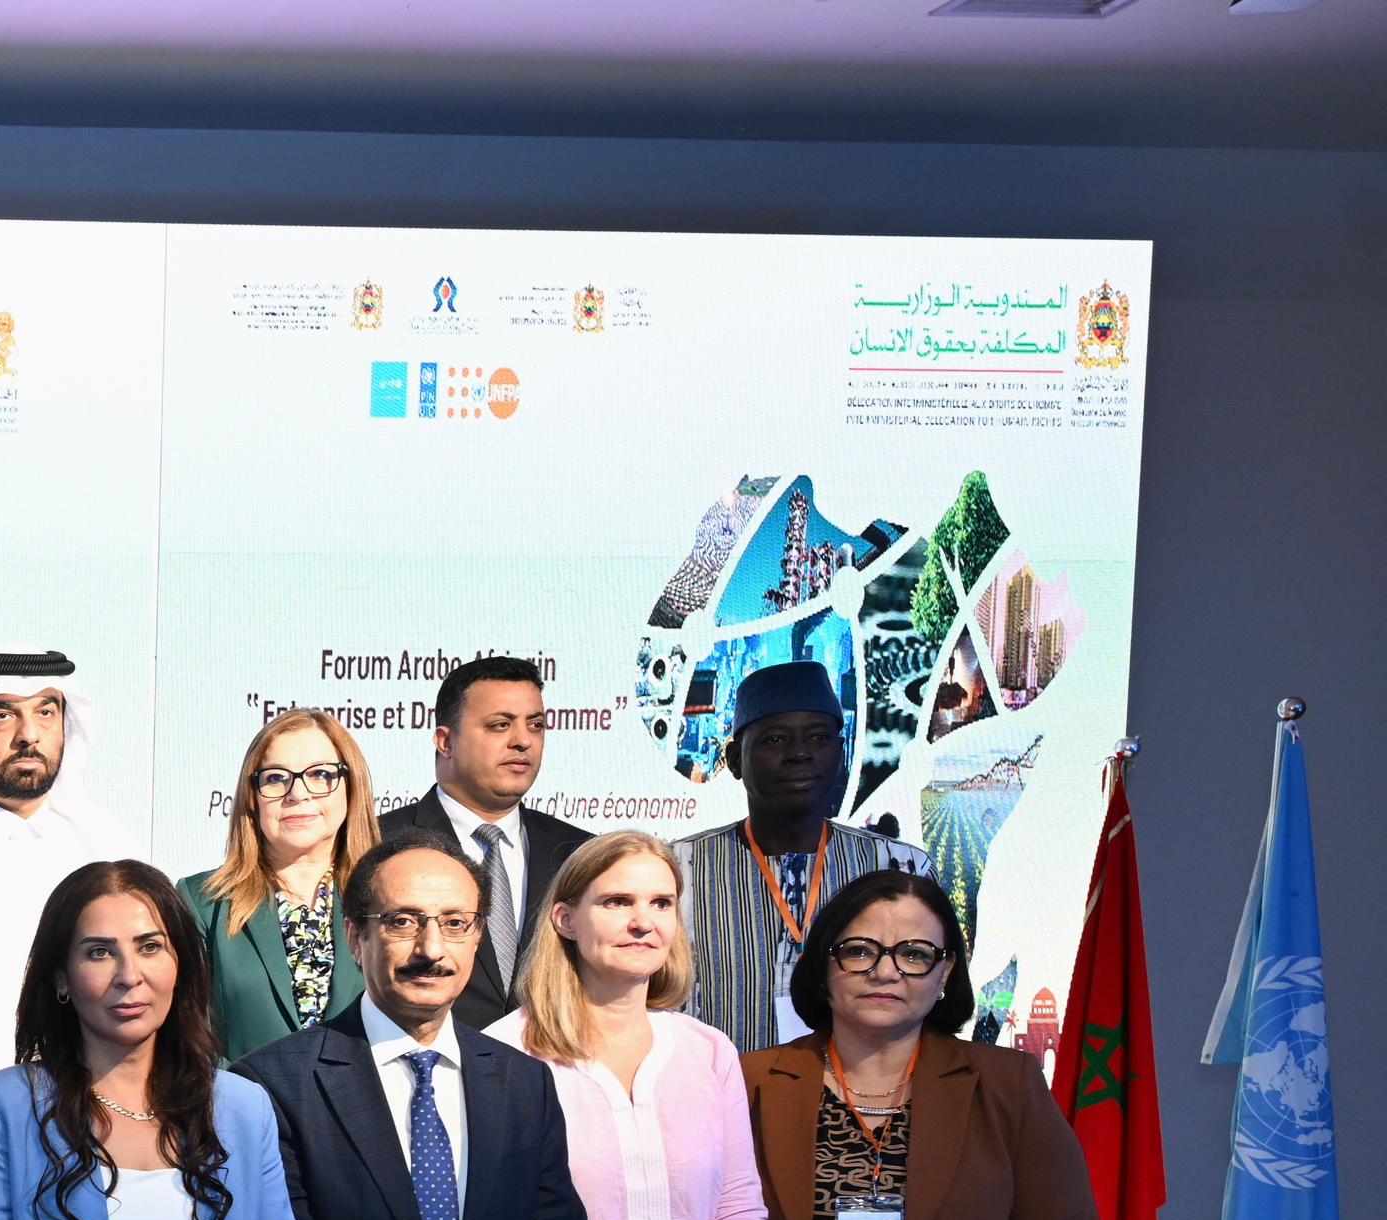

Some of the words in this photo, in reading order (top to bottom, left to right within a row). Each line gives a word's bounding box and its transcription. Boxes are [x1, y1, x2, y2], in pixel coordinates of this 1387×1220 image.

[853, 282, 960, 316] الوزارية
[964, 283, 1068, 316] المندوبية
[915, 327, 977, 361] بحقوق
[978, 329, 1067, 355] المكلفة
[321, 649, 391, 681] Forum
[383, 701, 405, 730] et
[546, 791, 599, 818] d'une
[602, 791, 698, 819] économie
